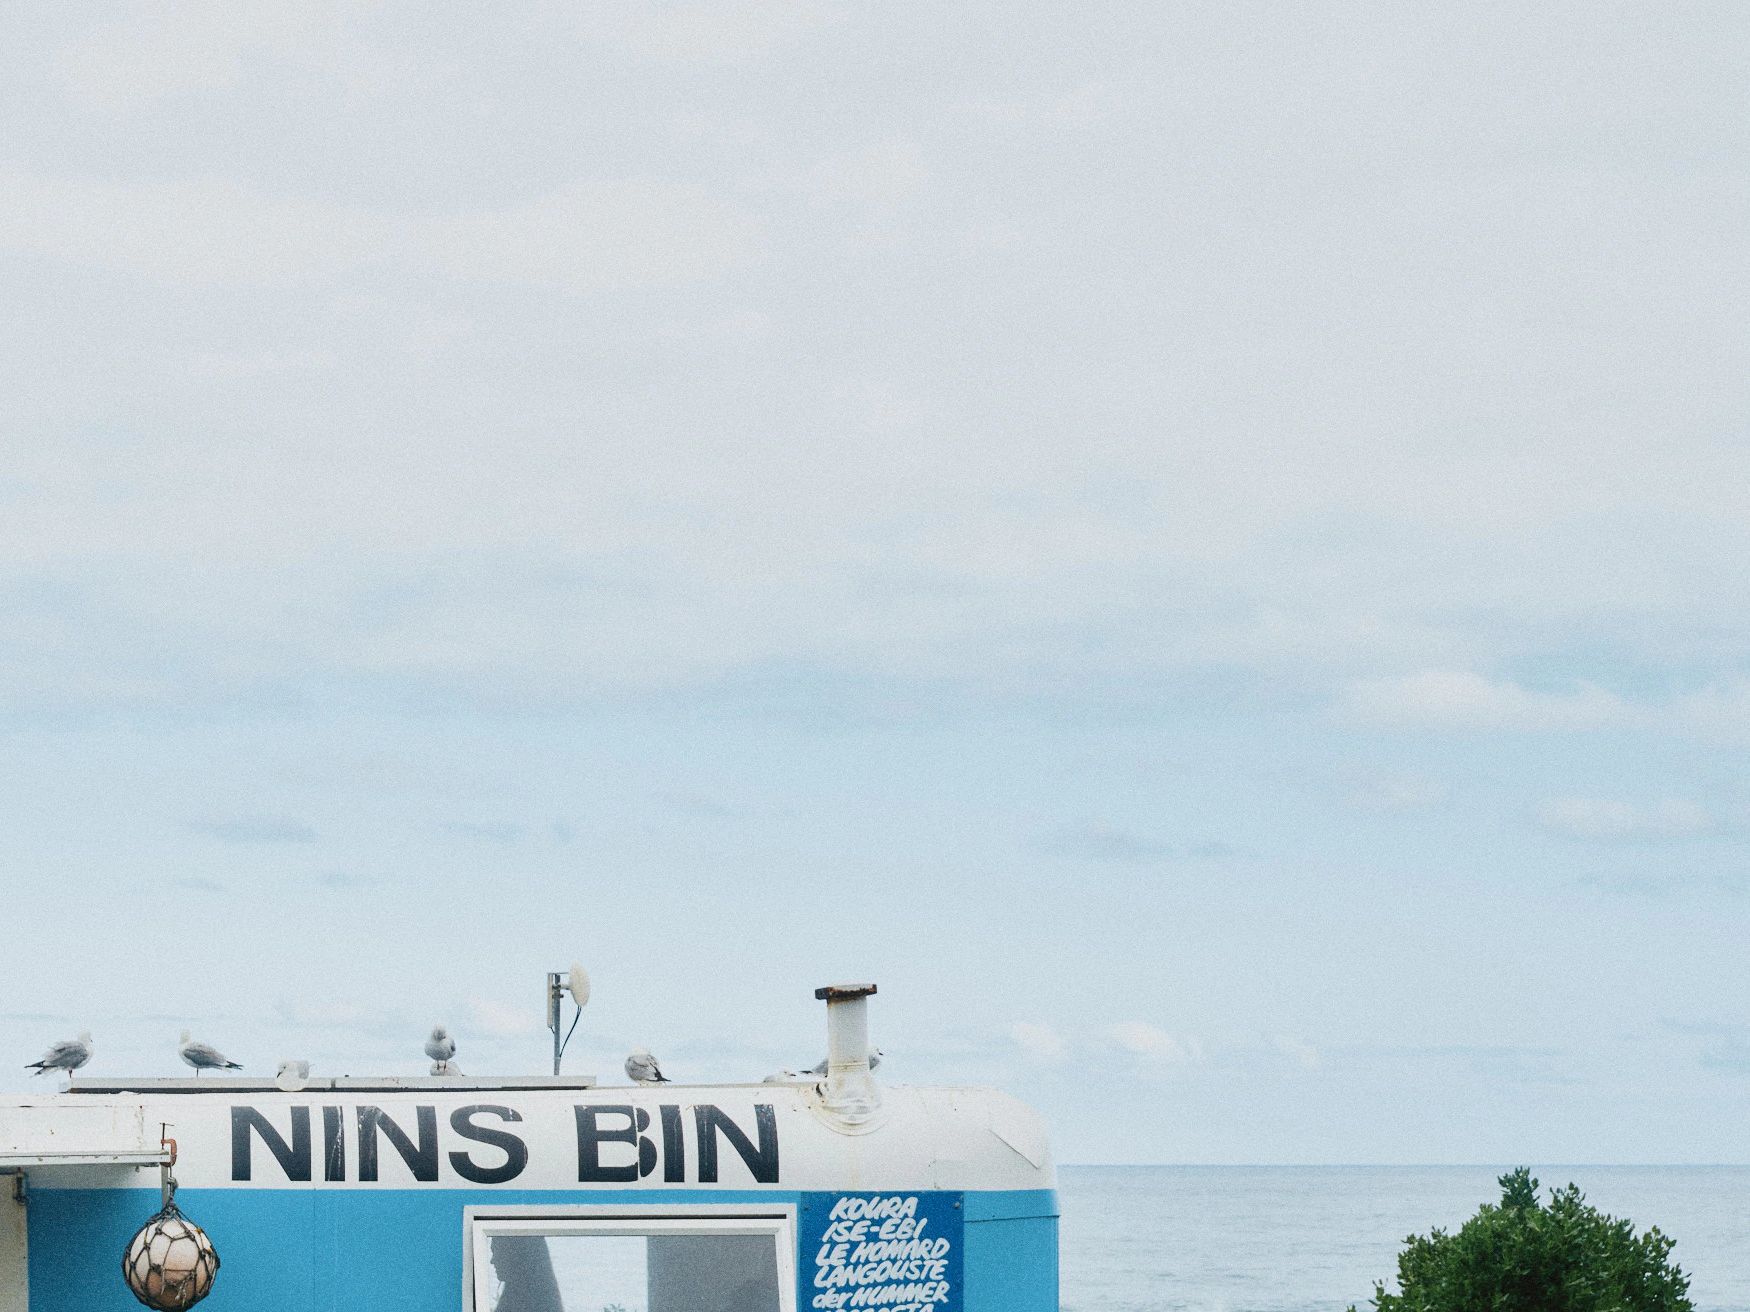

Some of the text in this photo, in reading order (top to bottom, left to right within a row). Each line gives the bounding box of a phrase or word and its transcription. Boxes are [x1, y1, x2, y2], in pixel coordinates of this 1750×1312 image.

[230, 1104, 780, 1184] NINS BIN
[829, 1196, 918, 1220] KOURA
[822, 1218, 927, 1242] ISE-EBI
[815, 1237, 950, 1266] LE HOMARD
[813, 1259, 948, 1288] LANGOUSTE
[850, 1281, 950, 1307] HUMMER
